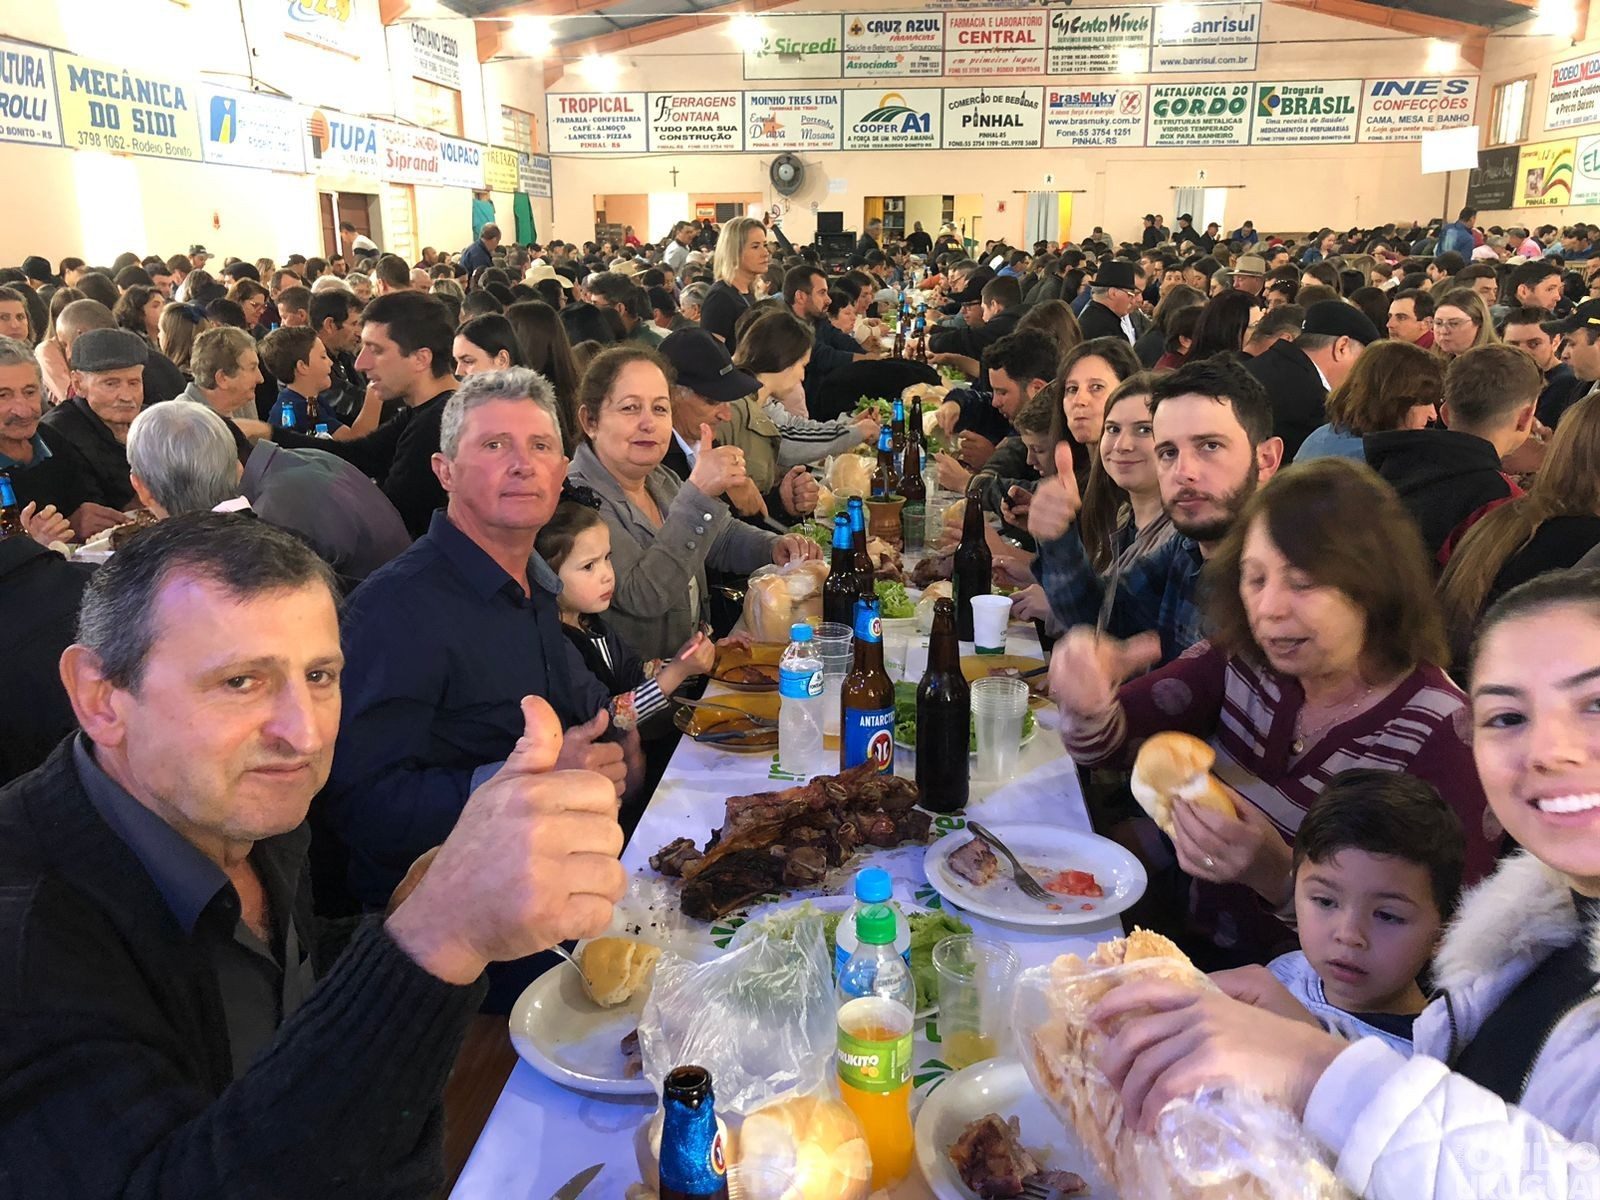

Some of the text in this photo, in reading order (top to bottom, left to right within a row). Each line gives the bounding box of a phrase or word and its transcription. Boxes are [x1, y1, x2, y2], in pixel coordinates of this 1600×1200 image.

[867, 19, 940, 33] CRUZ AZUL
[988, 18, 993, 27] E
[1185, 14, 1255, 33] anrisul
[958, 30, 1036, 44] CENTRAL
[775, 37, 836, 54] Sicredi
[846, 60, 898, 69] Associadas
[969, 56, 1009, 65] primeiro
[1012, 55, 1038, 64] lugar
[0, 51, 45, 89] LTURA
[67, 64, 188, 111] MECÂNICA
[1232, 85, 1248, 96] DO
[1281, 86, 1324, 97] Drogaria
[1370, 79, 1469, 97] INES
[1572, 88, 1579, 99] de
[559, 97, 634, 113] TROPICAL
[751, 95, 838, 106] MOINHO TRES LTDA
[993, 95, 1003, 103] DE
[1005, 90, 1039, 110] BEBIDAS
[1050, 91, 1116, 107] BrasMuky
[1279, 95, 1355, 116] BRASIL
[1373, 97, 1469, 113] CONFECÇÕES
[654, 95, 737, 122] FERRAGENS
[664, 108, 720, 122] FONTANA
[1153, 97, 1247, 118] GORDO
[88, 100, 177, 138] DO SIDI
[852, 112, 930, 133] COOPER A1
[962, 106, 1024, 127] PINHAL
[1048, 117, 1141, 126] www.brasmuky.com.br
[1366, 116, 1395, 124] CAMA,
[1399, 115, 1424, 123] MESA
[1437, 114, 1470, 122] BANHO
[6, 126, 35, 138] BONITO
[329, 121, 377, 155] TUPÃ
[659, 132, 732, 142] CONSTRUÇÃO
[853, 135, 870, 143] FORÇA
[1091, 128, 1111, 136] 3754
[1114, 128, 1131, 136] 1251
[78, 131, 192, 157] 3798 1062 Rodeio Bonito
[386, 148, 439, 174] Siprandi
[837, 1048, 880, 1067] RUKITO
